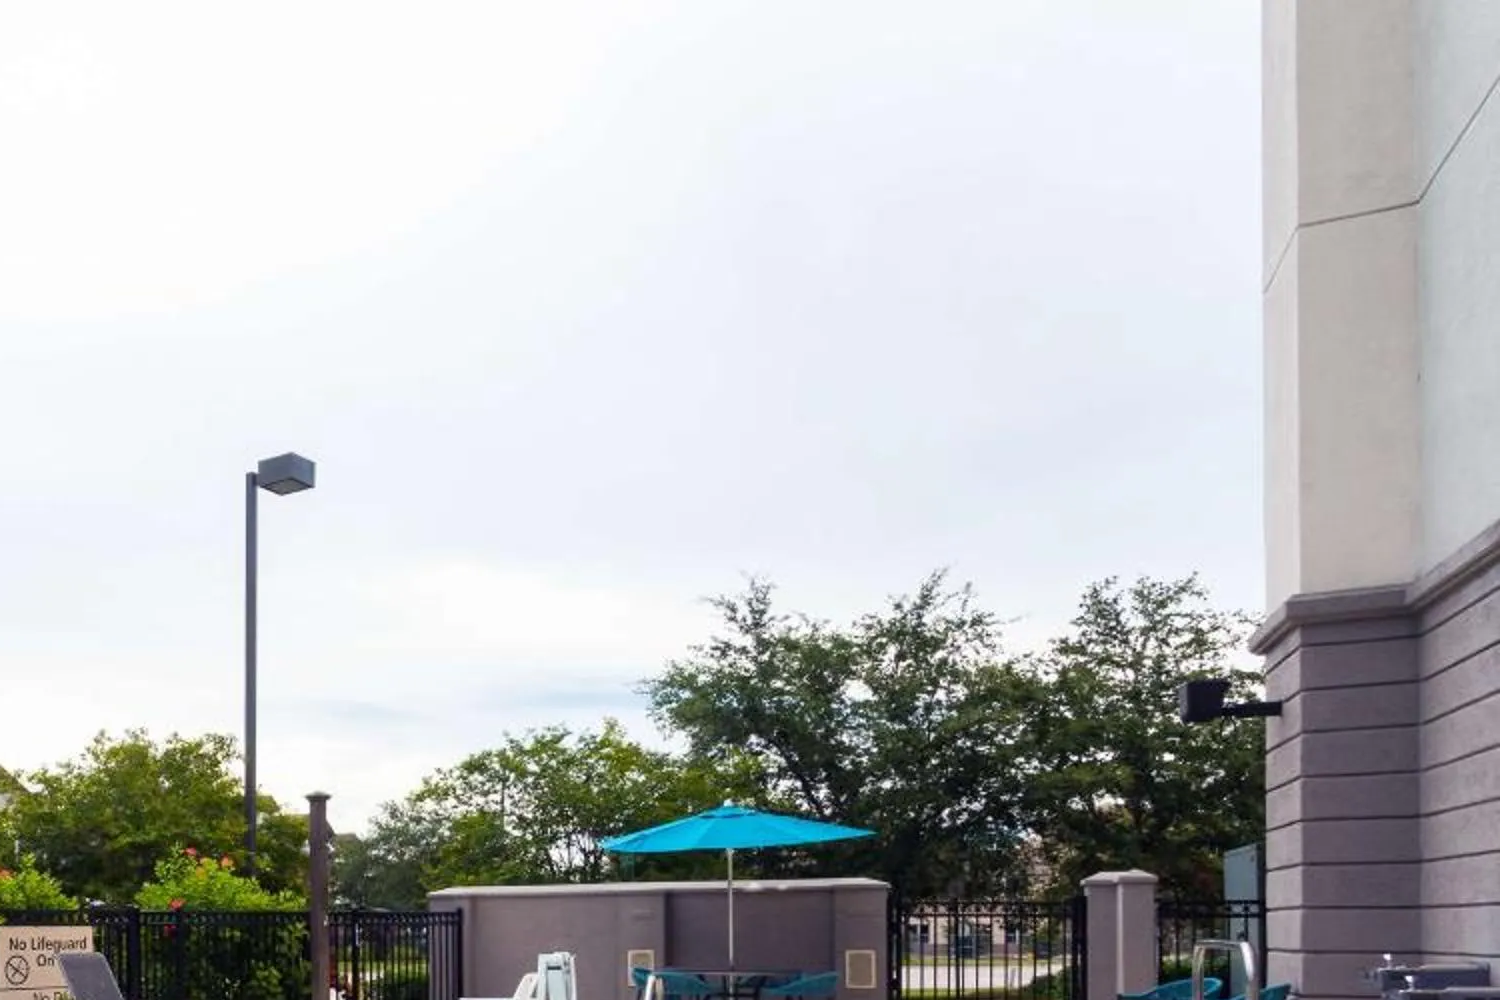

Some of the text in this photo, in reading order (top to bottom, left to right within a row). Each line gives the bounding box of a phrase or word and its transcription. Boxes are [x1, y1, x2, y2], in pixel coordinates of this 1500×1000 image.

[9, 936, 87, 953] No Lifeguard
[36, 954, 55, 967] On
